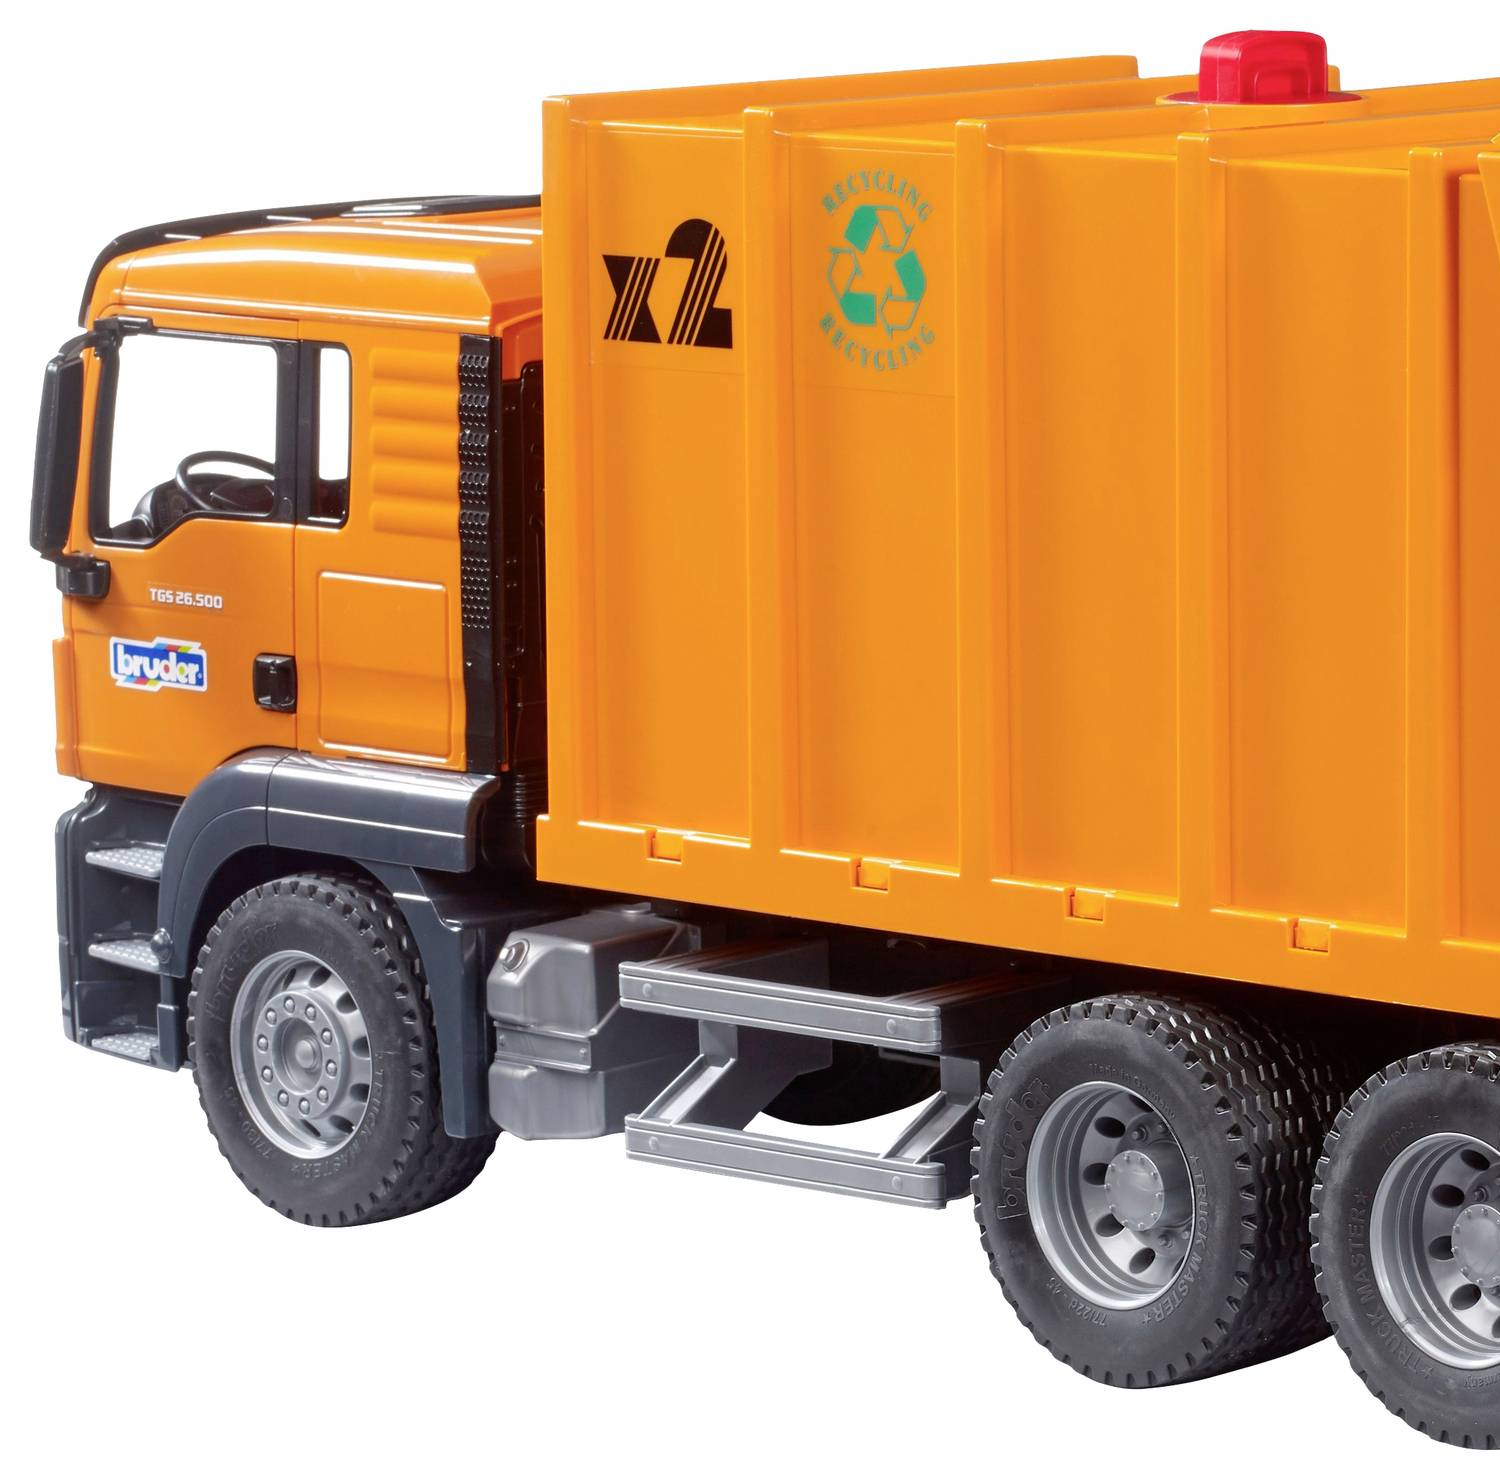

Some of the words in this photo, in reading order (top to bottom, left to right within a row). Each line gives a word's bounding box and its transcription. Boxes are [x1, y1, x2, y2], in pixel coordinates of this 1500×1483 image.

[821, 169, 934, 222] RECYCLING
[819, 311, 936, 371] RECYCLING
[149, 588, 174, 603] TGS
[175, 591, 223, 609] 26.500
[117, 643, 200, 685] bruder
[997, 1078, 1050, 1220] bruder
[1194, 1169, 1209, 1249] TRUCK
[1153, 1251, 1203, 1322] MASTER
[1348, 1207, 1375, 1304] MASTER
[1366, 1306, 1423, 1376] TRUCK
